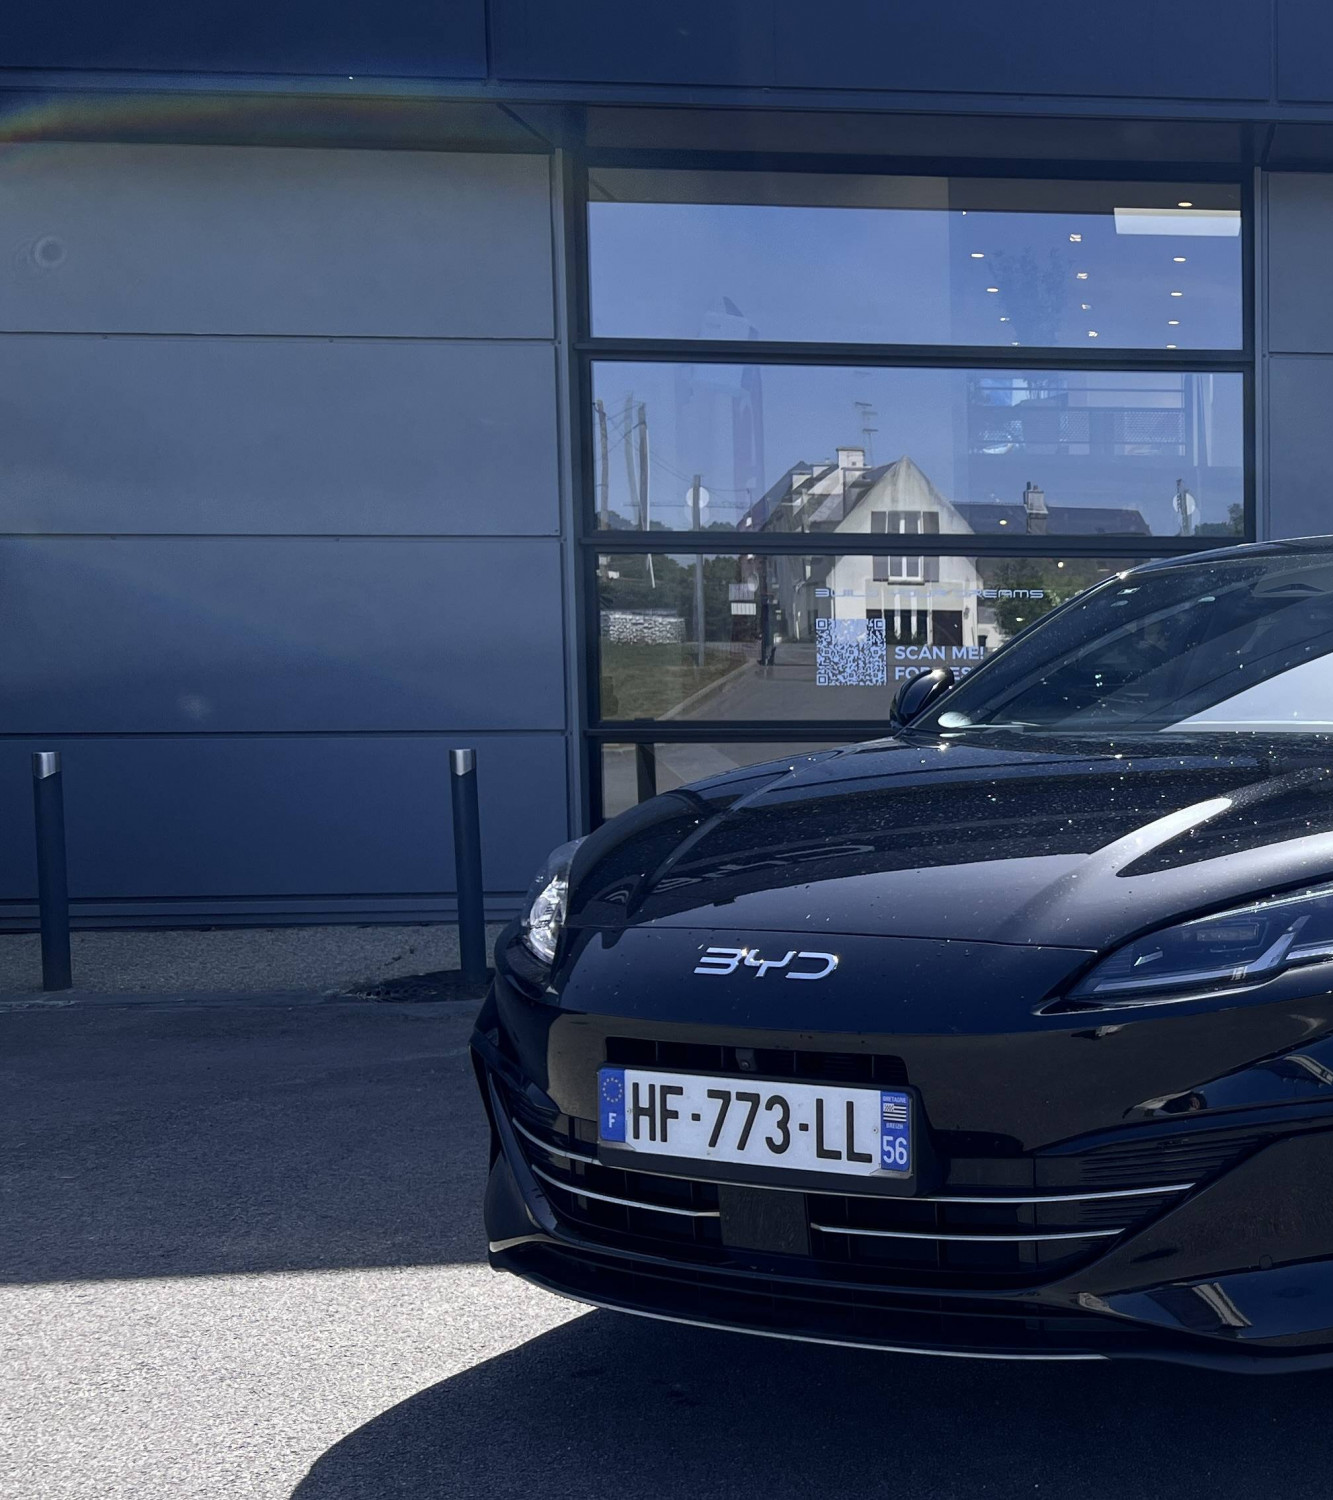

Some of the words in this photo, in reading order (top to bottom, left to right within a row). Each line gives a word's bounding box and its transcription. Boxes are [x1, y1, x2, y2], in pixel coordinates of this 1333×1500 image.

[895, 646, 945, 660] SCAN
[952, 646, 984, 660] ME!
[694, 947, 838, 979] BYD
[608, 1112, 617, 1128] F
[632, 1082, 872, 1163] HF-773-LL
[882, 1135, 908, 1165] 56
